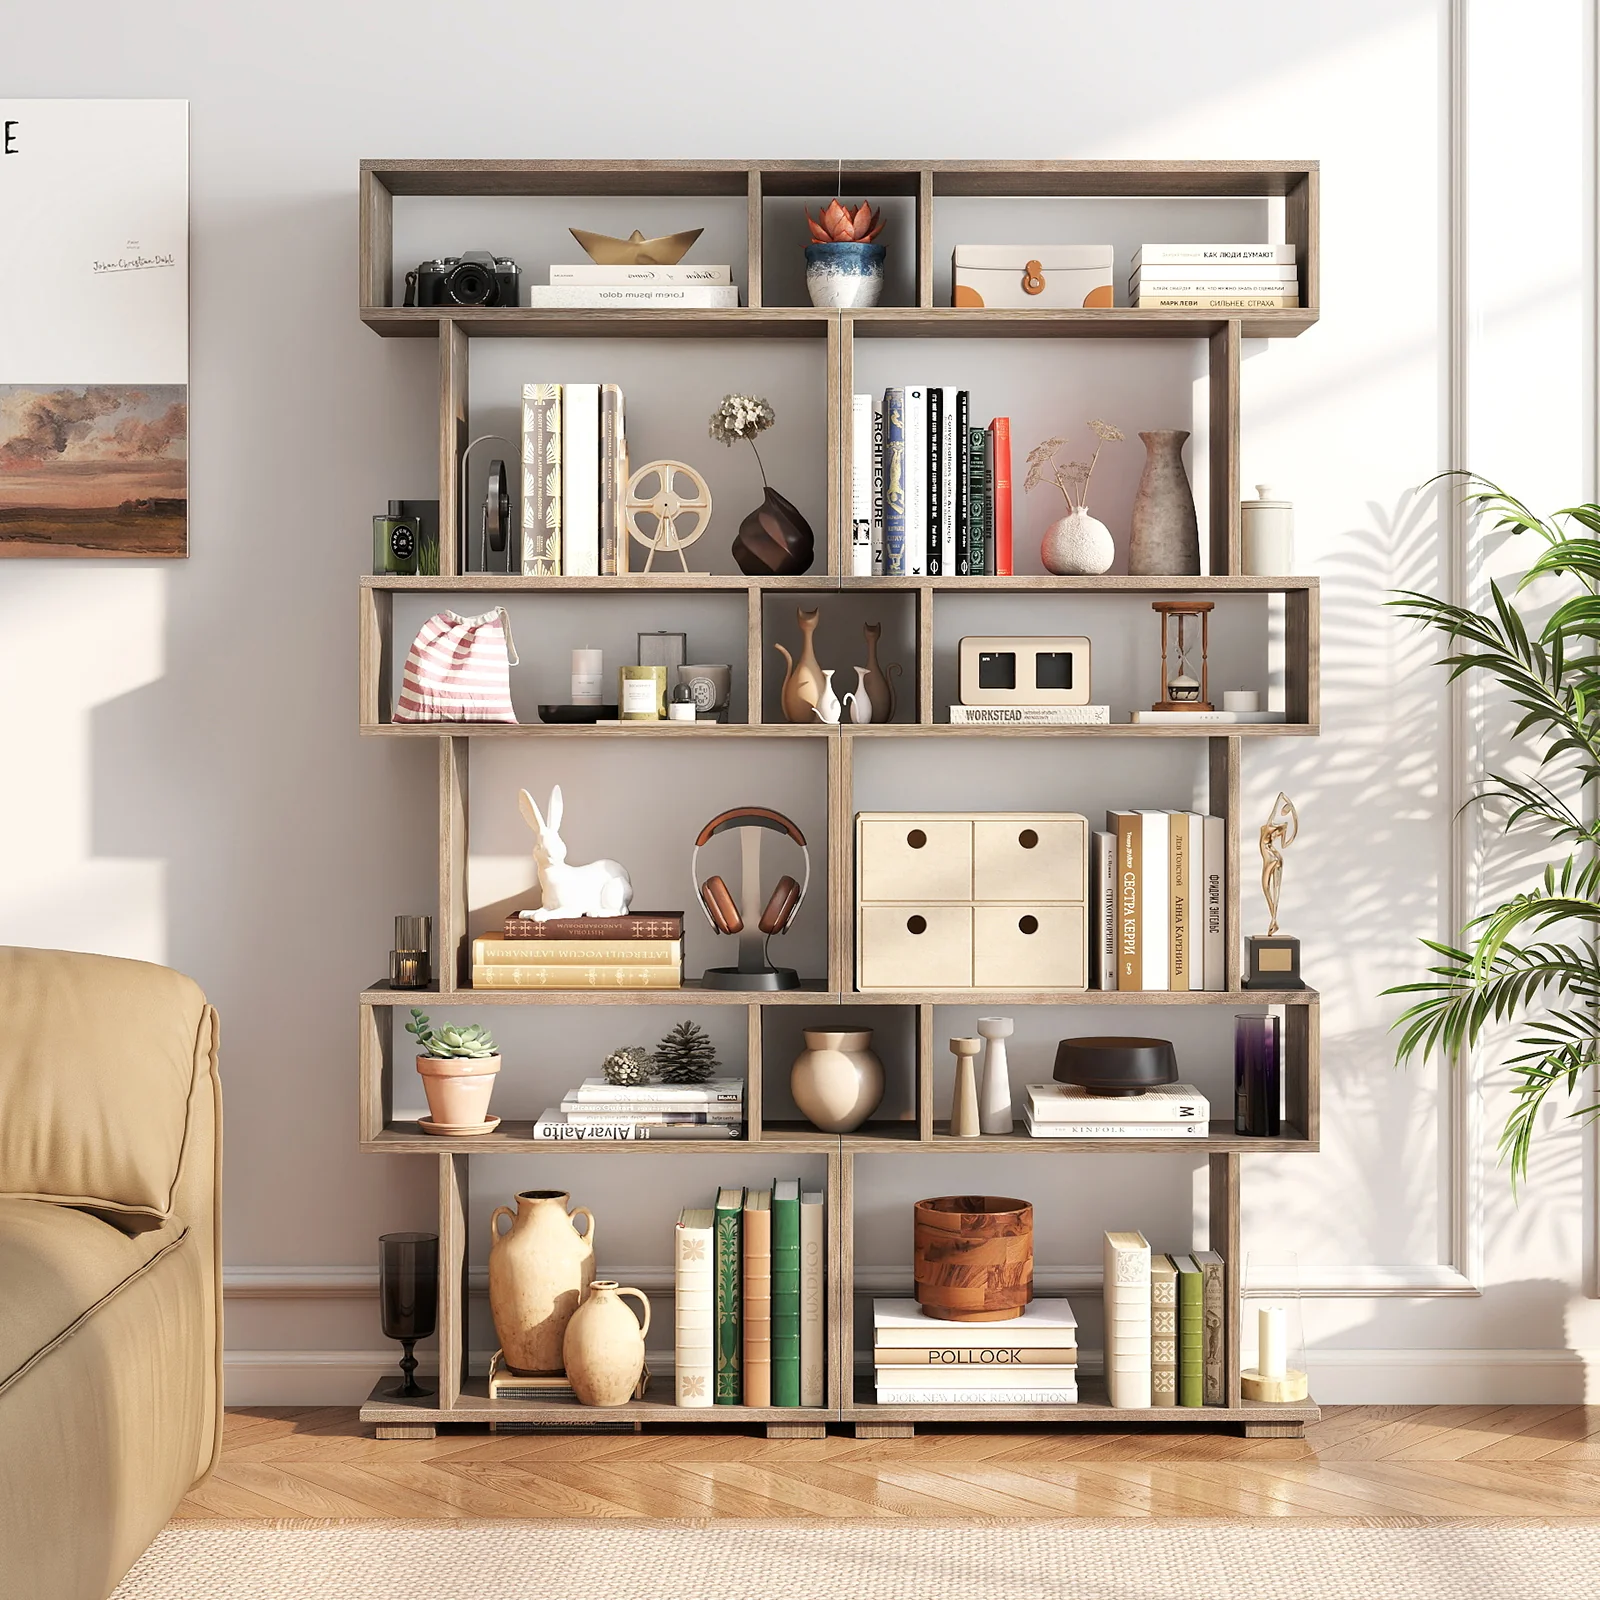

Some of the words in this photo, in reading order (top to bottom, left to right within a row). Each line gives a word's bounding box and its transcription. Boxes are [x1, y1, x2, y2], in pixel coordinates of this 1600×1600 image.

[93, 261, 117, 271] Johan
[118, 255, 154, 268] Christian
[155, 254, 175, 265] Dahl
[1209, 299, 1245, 307] СИЛЬНЕЕ
[1247, 299, 1275, 307] СТРАХА
[874, 411, 883, 528] ARCHITECTURE
[966, 709, 1022, 721] WORKSTEAD
[1124, 872, 1136, 916] СЕСТРА
[1209, 874, 1220, 904] ФРИДРИХ
[1209, 906, 1220, 934] ЭНГЕЛЬС
[1124, 919, 1136, 955] КЕРРИ
[486, 950, 554, 958] LATINARUM
[559, 950, 603, 958] VOCUM
[606, 950, 669, 959] LATERCULI
[543, 1126, 586, 1139] Aalto
[588, 1126, 630, 1139] Alvar
[805, 1241, 819, 1323] LUXDECO
[928, 1349, 1022, 1364] POLLOCK
[953, 1393, 986, 1403] LOOK
[990, 1393, 1068, 1403] REVOLUTION
